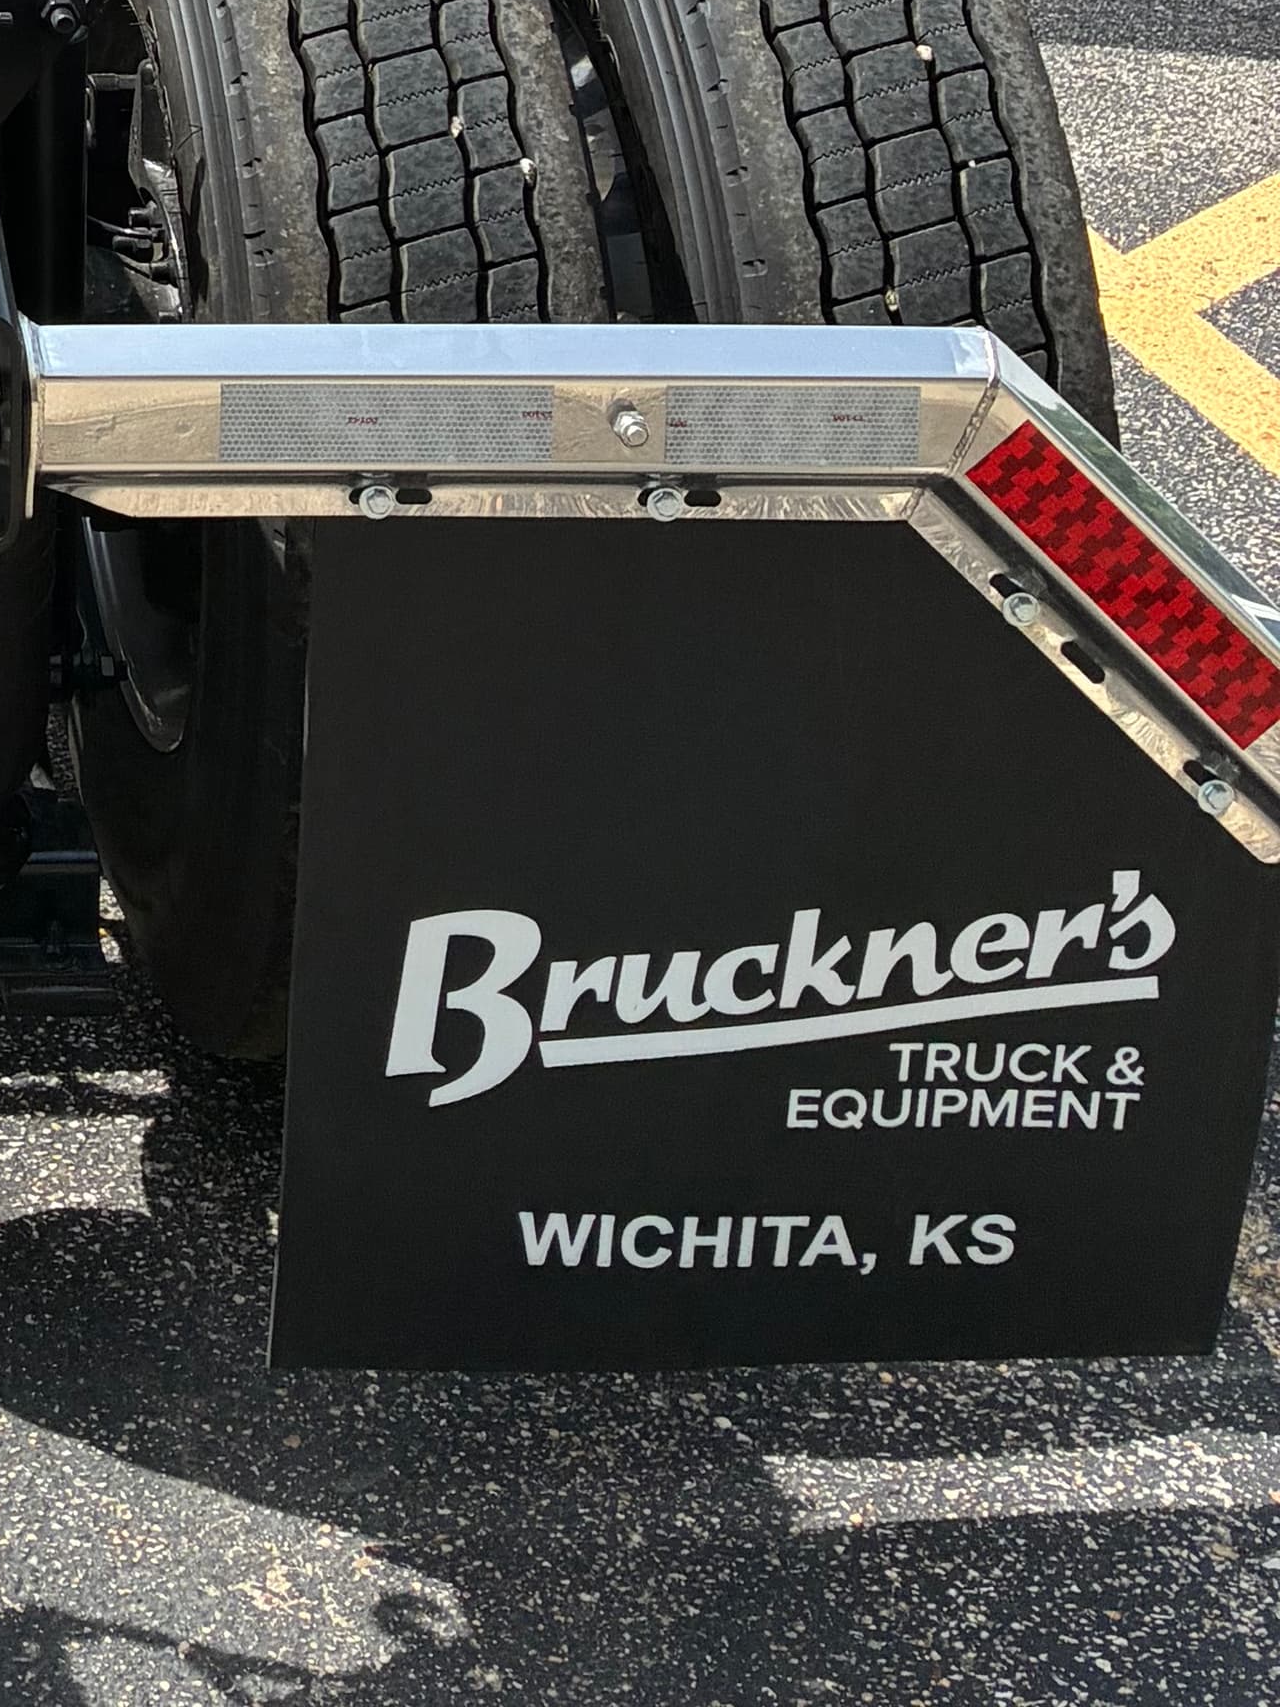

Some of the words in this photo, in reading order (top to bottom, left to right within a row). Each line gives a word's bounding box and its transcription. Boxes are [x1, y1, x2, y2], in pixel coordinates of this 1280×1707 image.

[385, 869, 1176, 1108] Bruckner's
[889, 1042, 1092, 1085] TRUCK
[1105, 1045, 1145, 1086] &
[786, 1088, 1141, 1131] EQUIPMENT
[518, 1211, 877, 1275] WICHITA,
[909, 1214, 1017, 1266] KS
